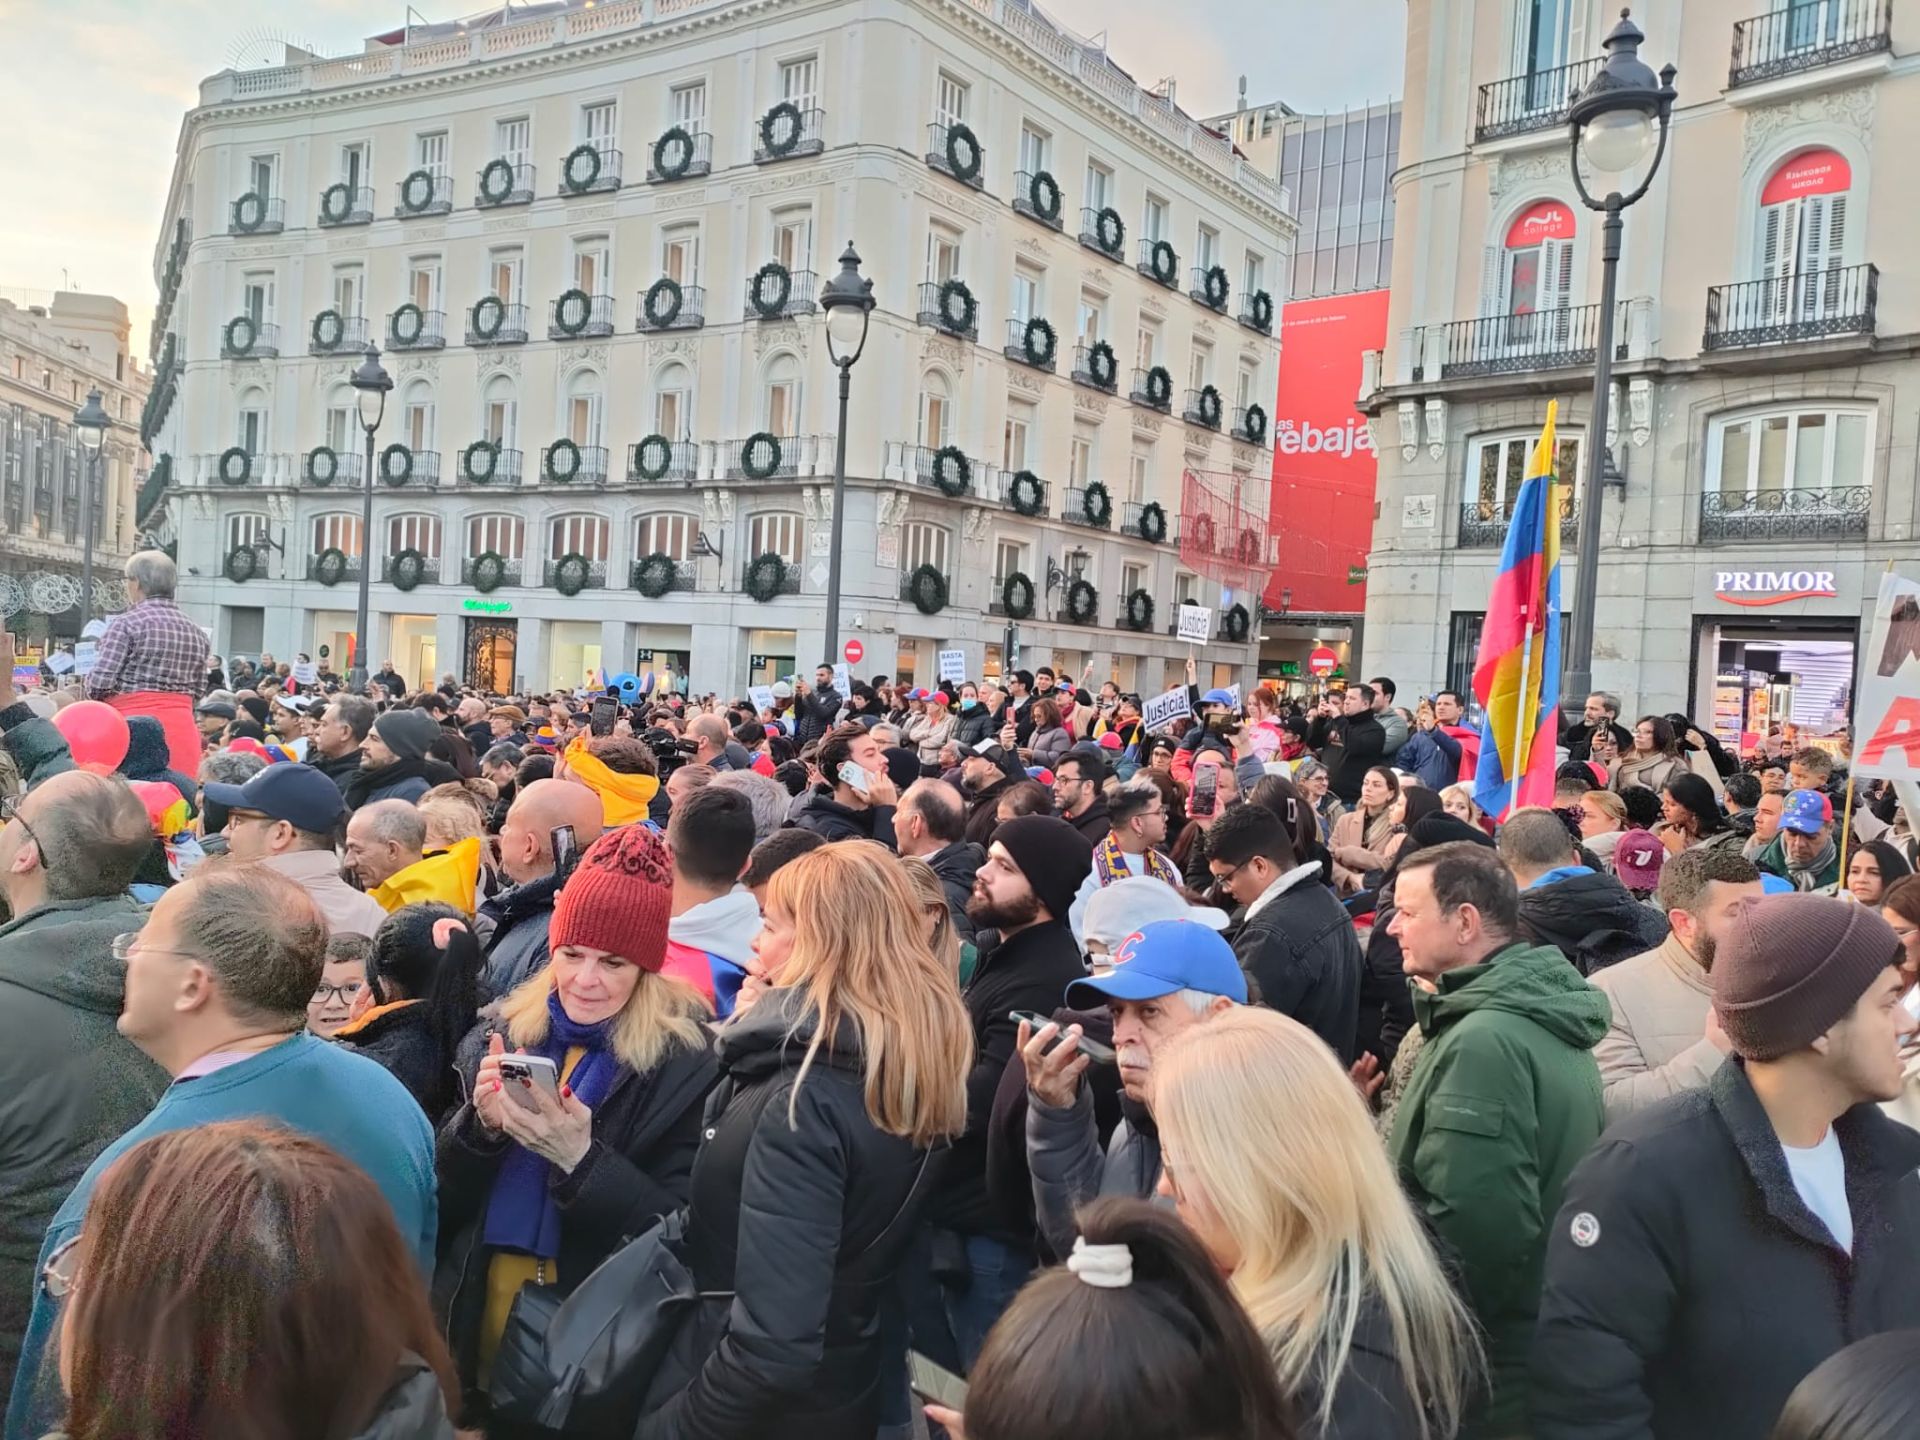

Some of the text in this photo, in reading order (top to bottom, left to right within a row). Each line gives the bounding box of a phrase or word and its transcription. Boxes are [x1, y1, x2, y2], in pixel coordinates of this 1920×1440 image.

[1715, 571, 1837, 592] PRIMOR
[941, 652, 963, 660] BASTA
[1145, 688, 1189, 725] Justicia!
[1114, 931, 1146, 966] C
